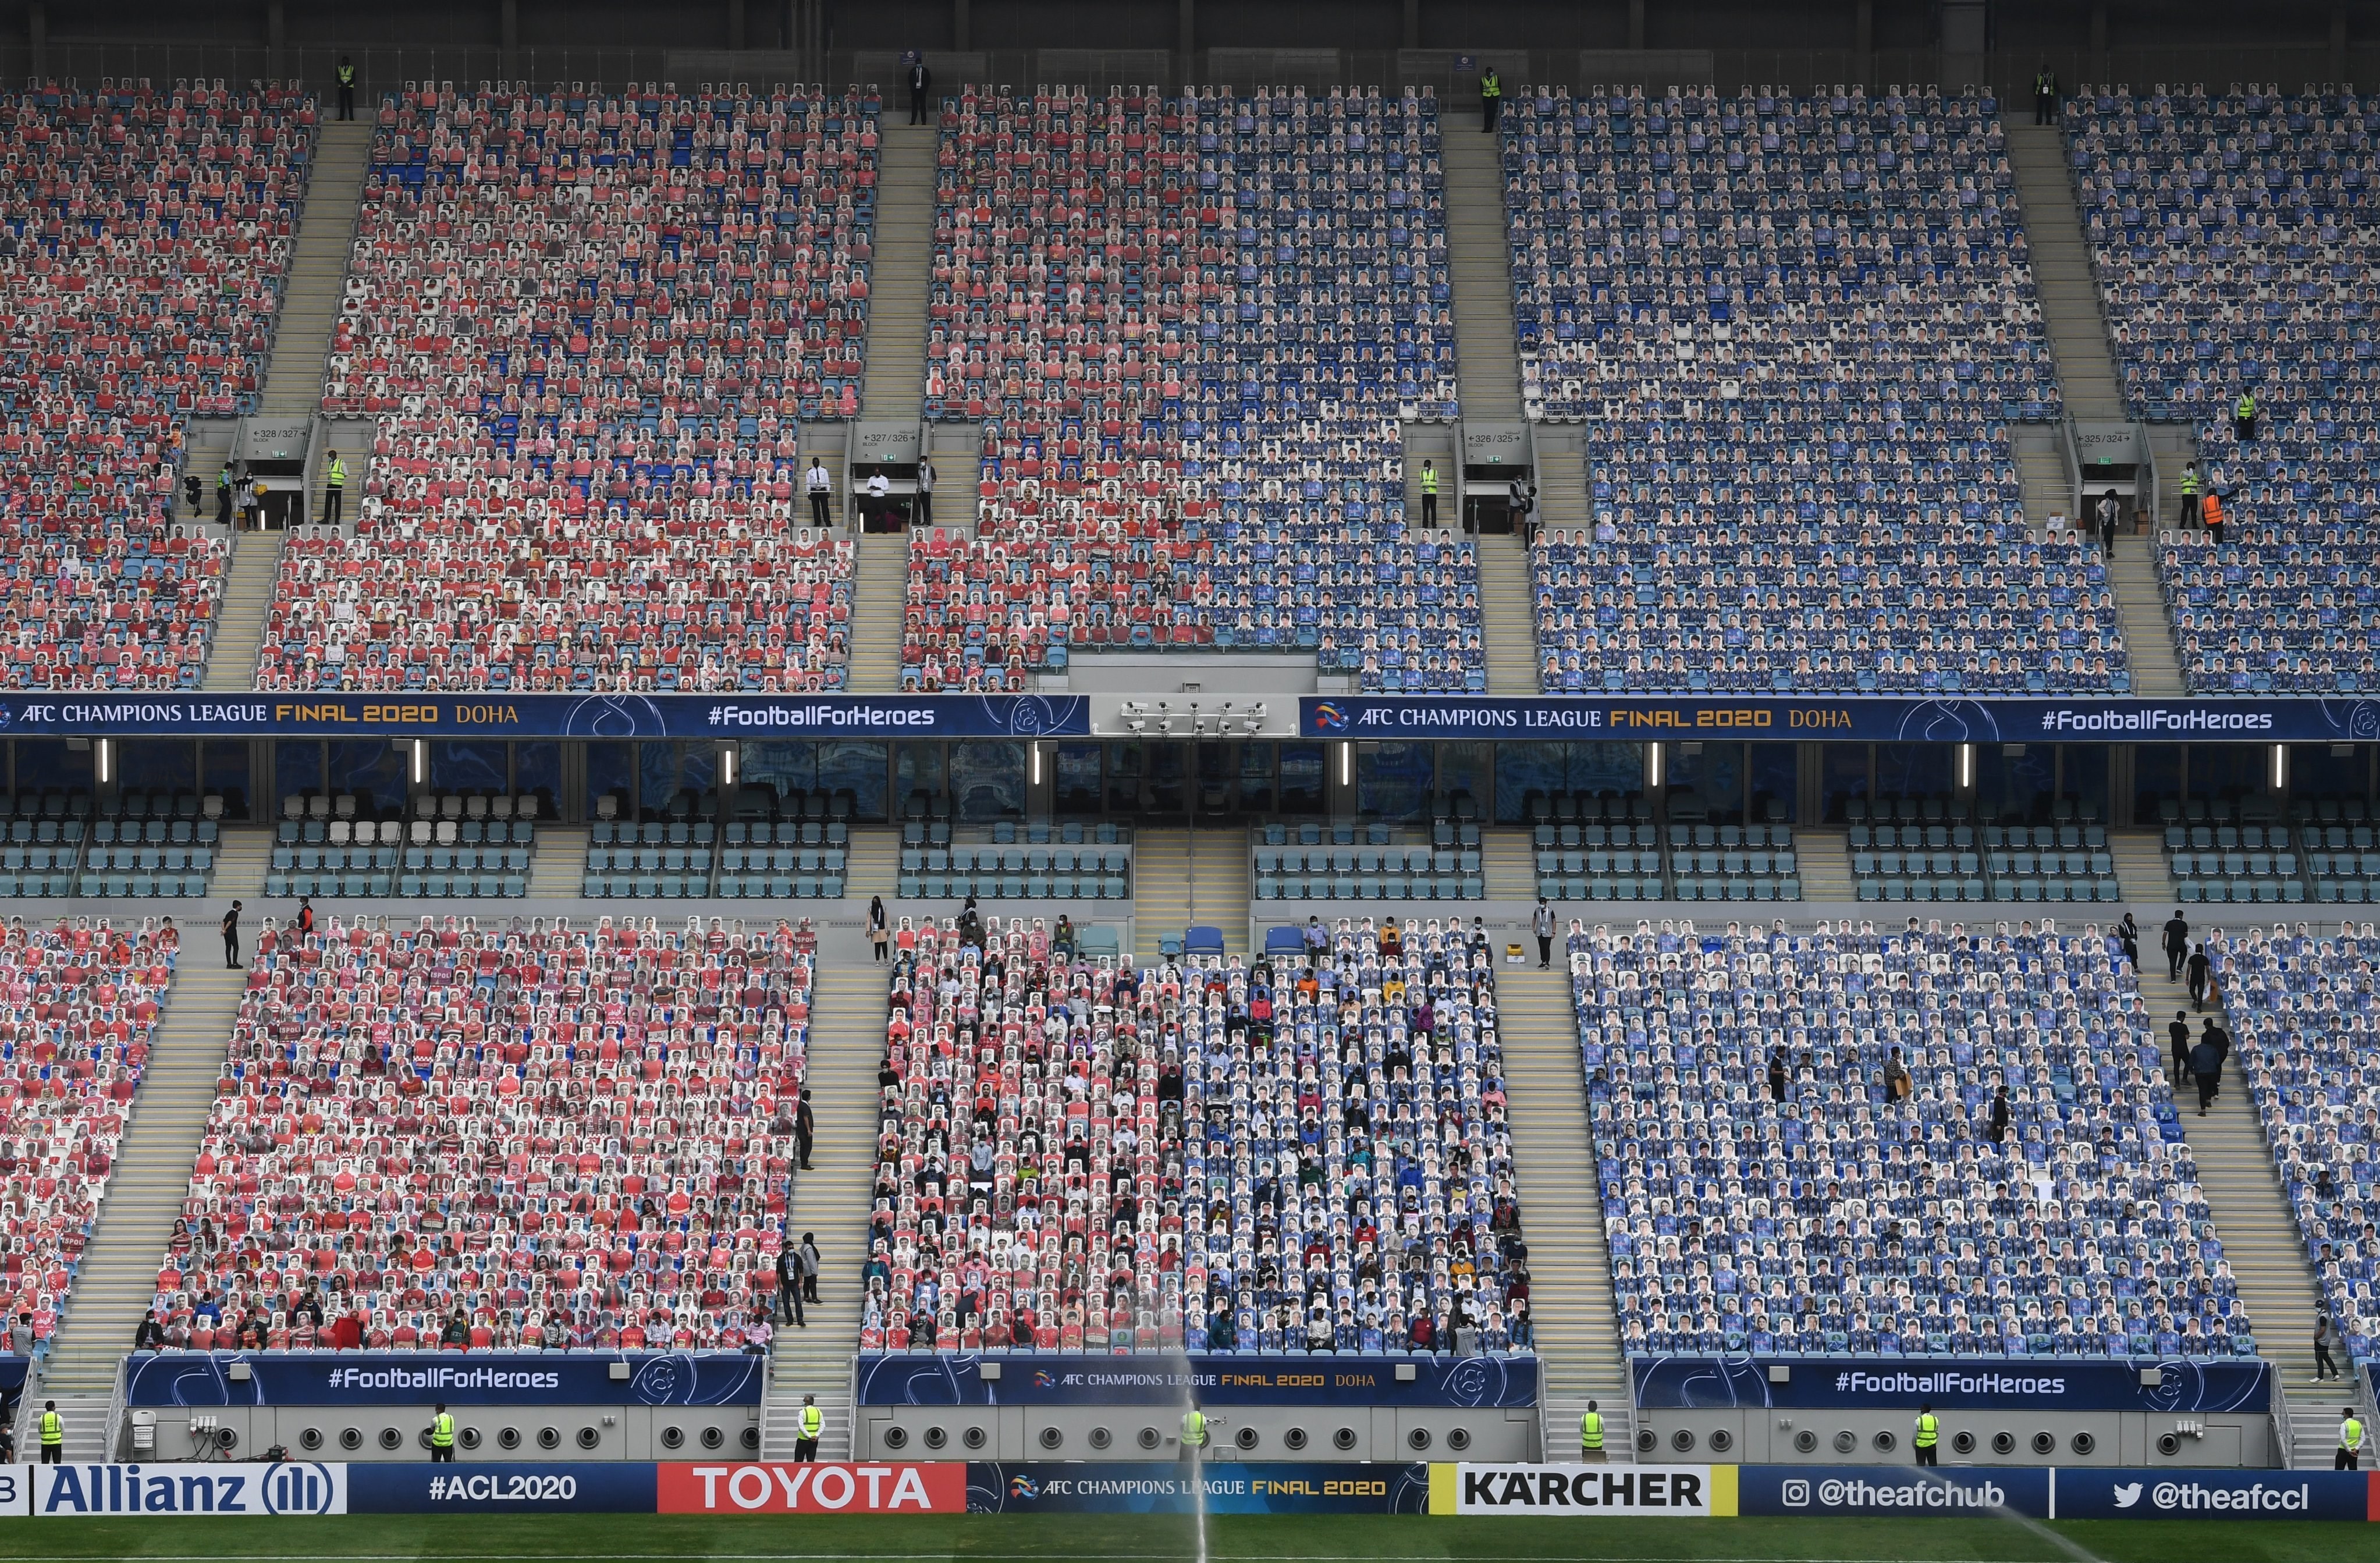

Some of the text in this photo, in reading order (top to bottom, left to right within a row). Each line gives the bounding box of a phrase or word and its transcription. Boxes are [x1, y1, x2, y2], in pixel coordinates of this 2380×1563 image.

[20, 705, 517, 722] AFC CHAMPIONS LEAGUE FINAL 2020 DOHA
[708, 706, 935, 726] #FootballForHeroes
[1358, 709, 1852, 727] AFC CHAMPIONS LEAGUE FINAL 2020 DOHA
[2041, 709, 2272, 730] #FootballForHeroes
[329, 1367, 559, 1388] #FootballForHeroes
[1061, 1374, 1376, 1386] AFC CHAMPIONS LEAGUE FINAL 2020 DOHA
[1835, 1372, 2065, 1394] #FootballForHeroes
[45, 1465, 247, 1512] Allianz
[429, 1475, 577, 1500] #ACL2020
[692, 1466, 932, 1509] TOYOTA
[1042, 1480, 1072, 1494] AFC
[1077, 1480, 1175, 1495] CHAMPIONS
[1252, 1481, 1320, 1495] FINAL
[1324, 1481, 1387, 1495] 2020
[1465, 1470, 1703, 1507] KÄRCHER
[1818, 1478, 2006, 1508] @theafchub
[2152, 1482, 2309, 1510] @theafccl
